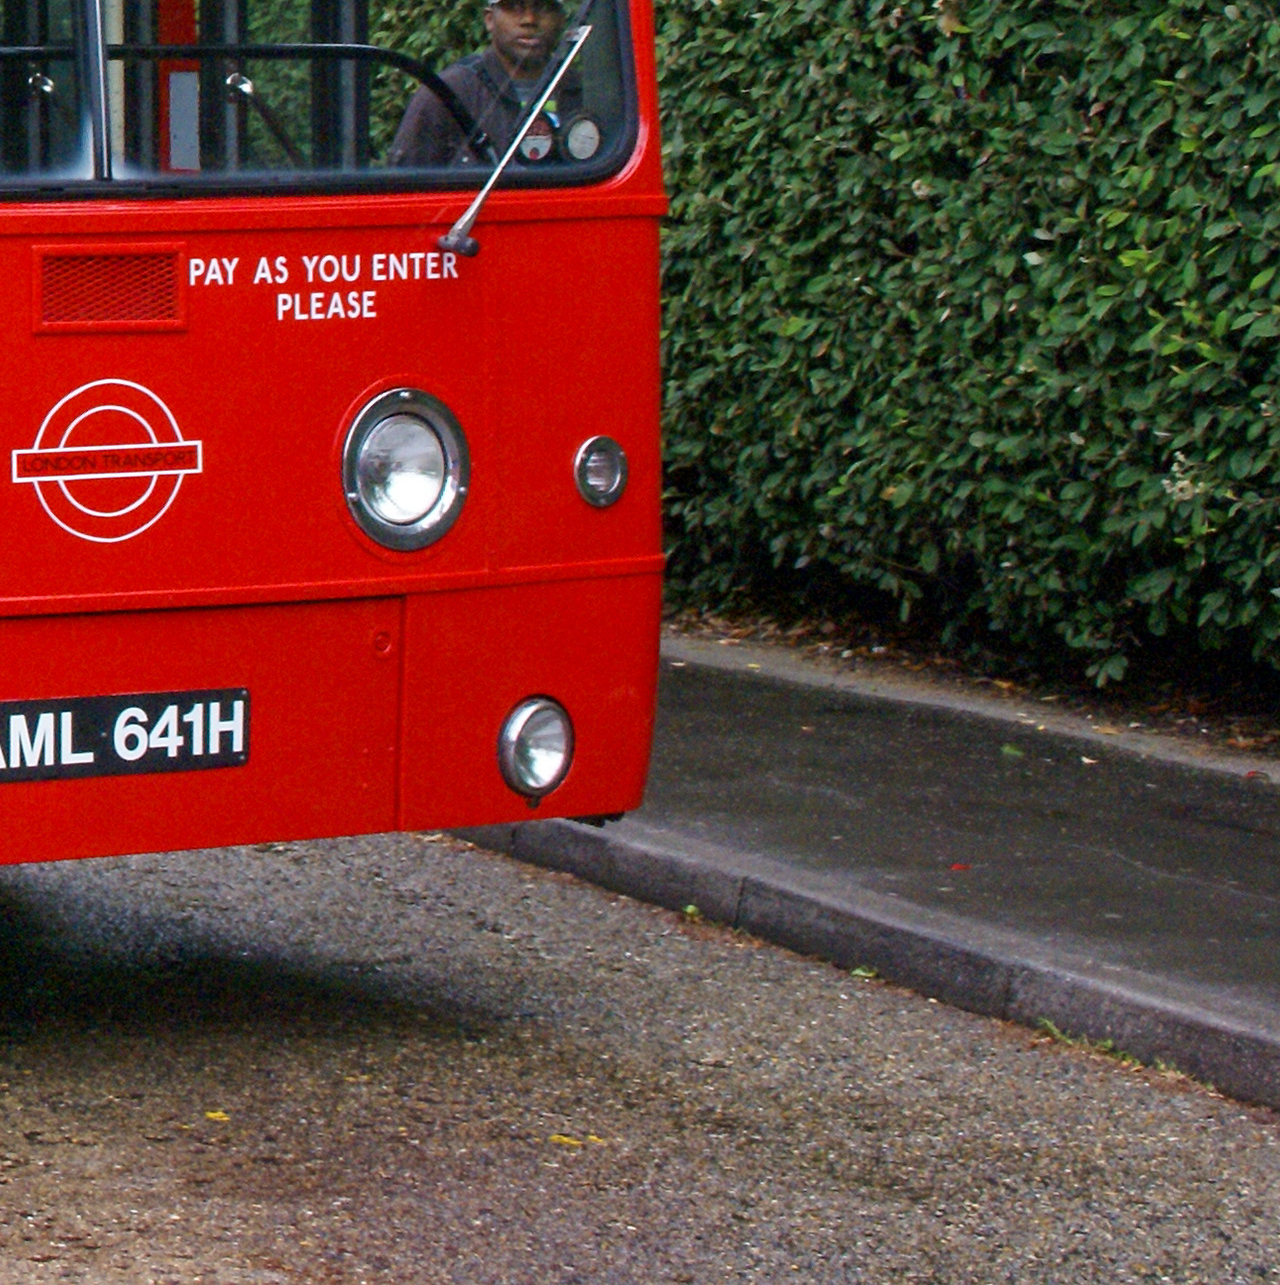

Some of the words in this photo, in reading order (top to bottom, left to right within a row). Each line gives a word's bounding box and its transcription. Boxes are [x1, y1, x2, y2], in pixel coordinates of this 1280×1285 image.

[189, 257, 239, 286] PAY
[253, 256, 289, 285] AS
[302, 254, 361, 283] YOU
[372, 252, 458, 281] ENTER
[277, 290, 377, 321] PLEASE
[22, 456, 96, 474] LONDON
[102, 450, 195, 468] TRANSPORT
[113, 700, 244, 761] 641H
